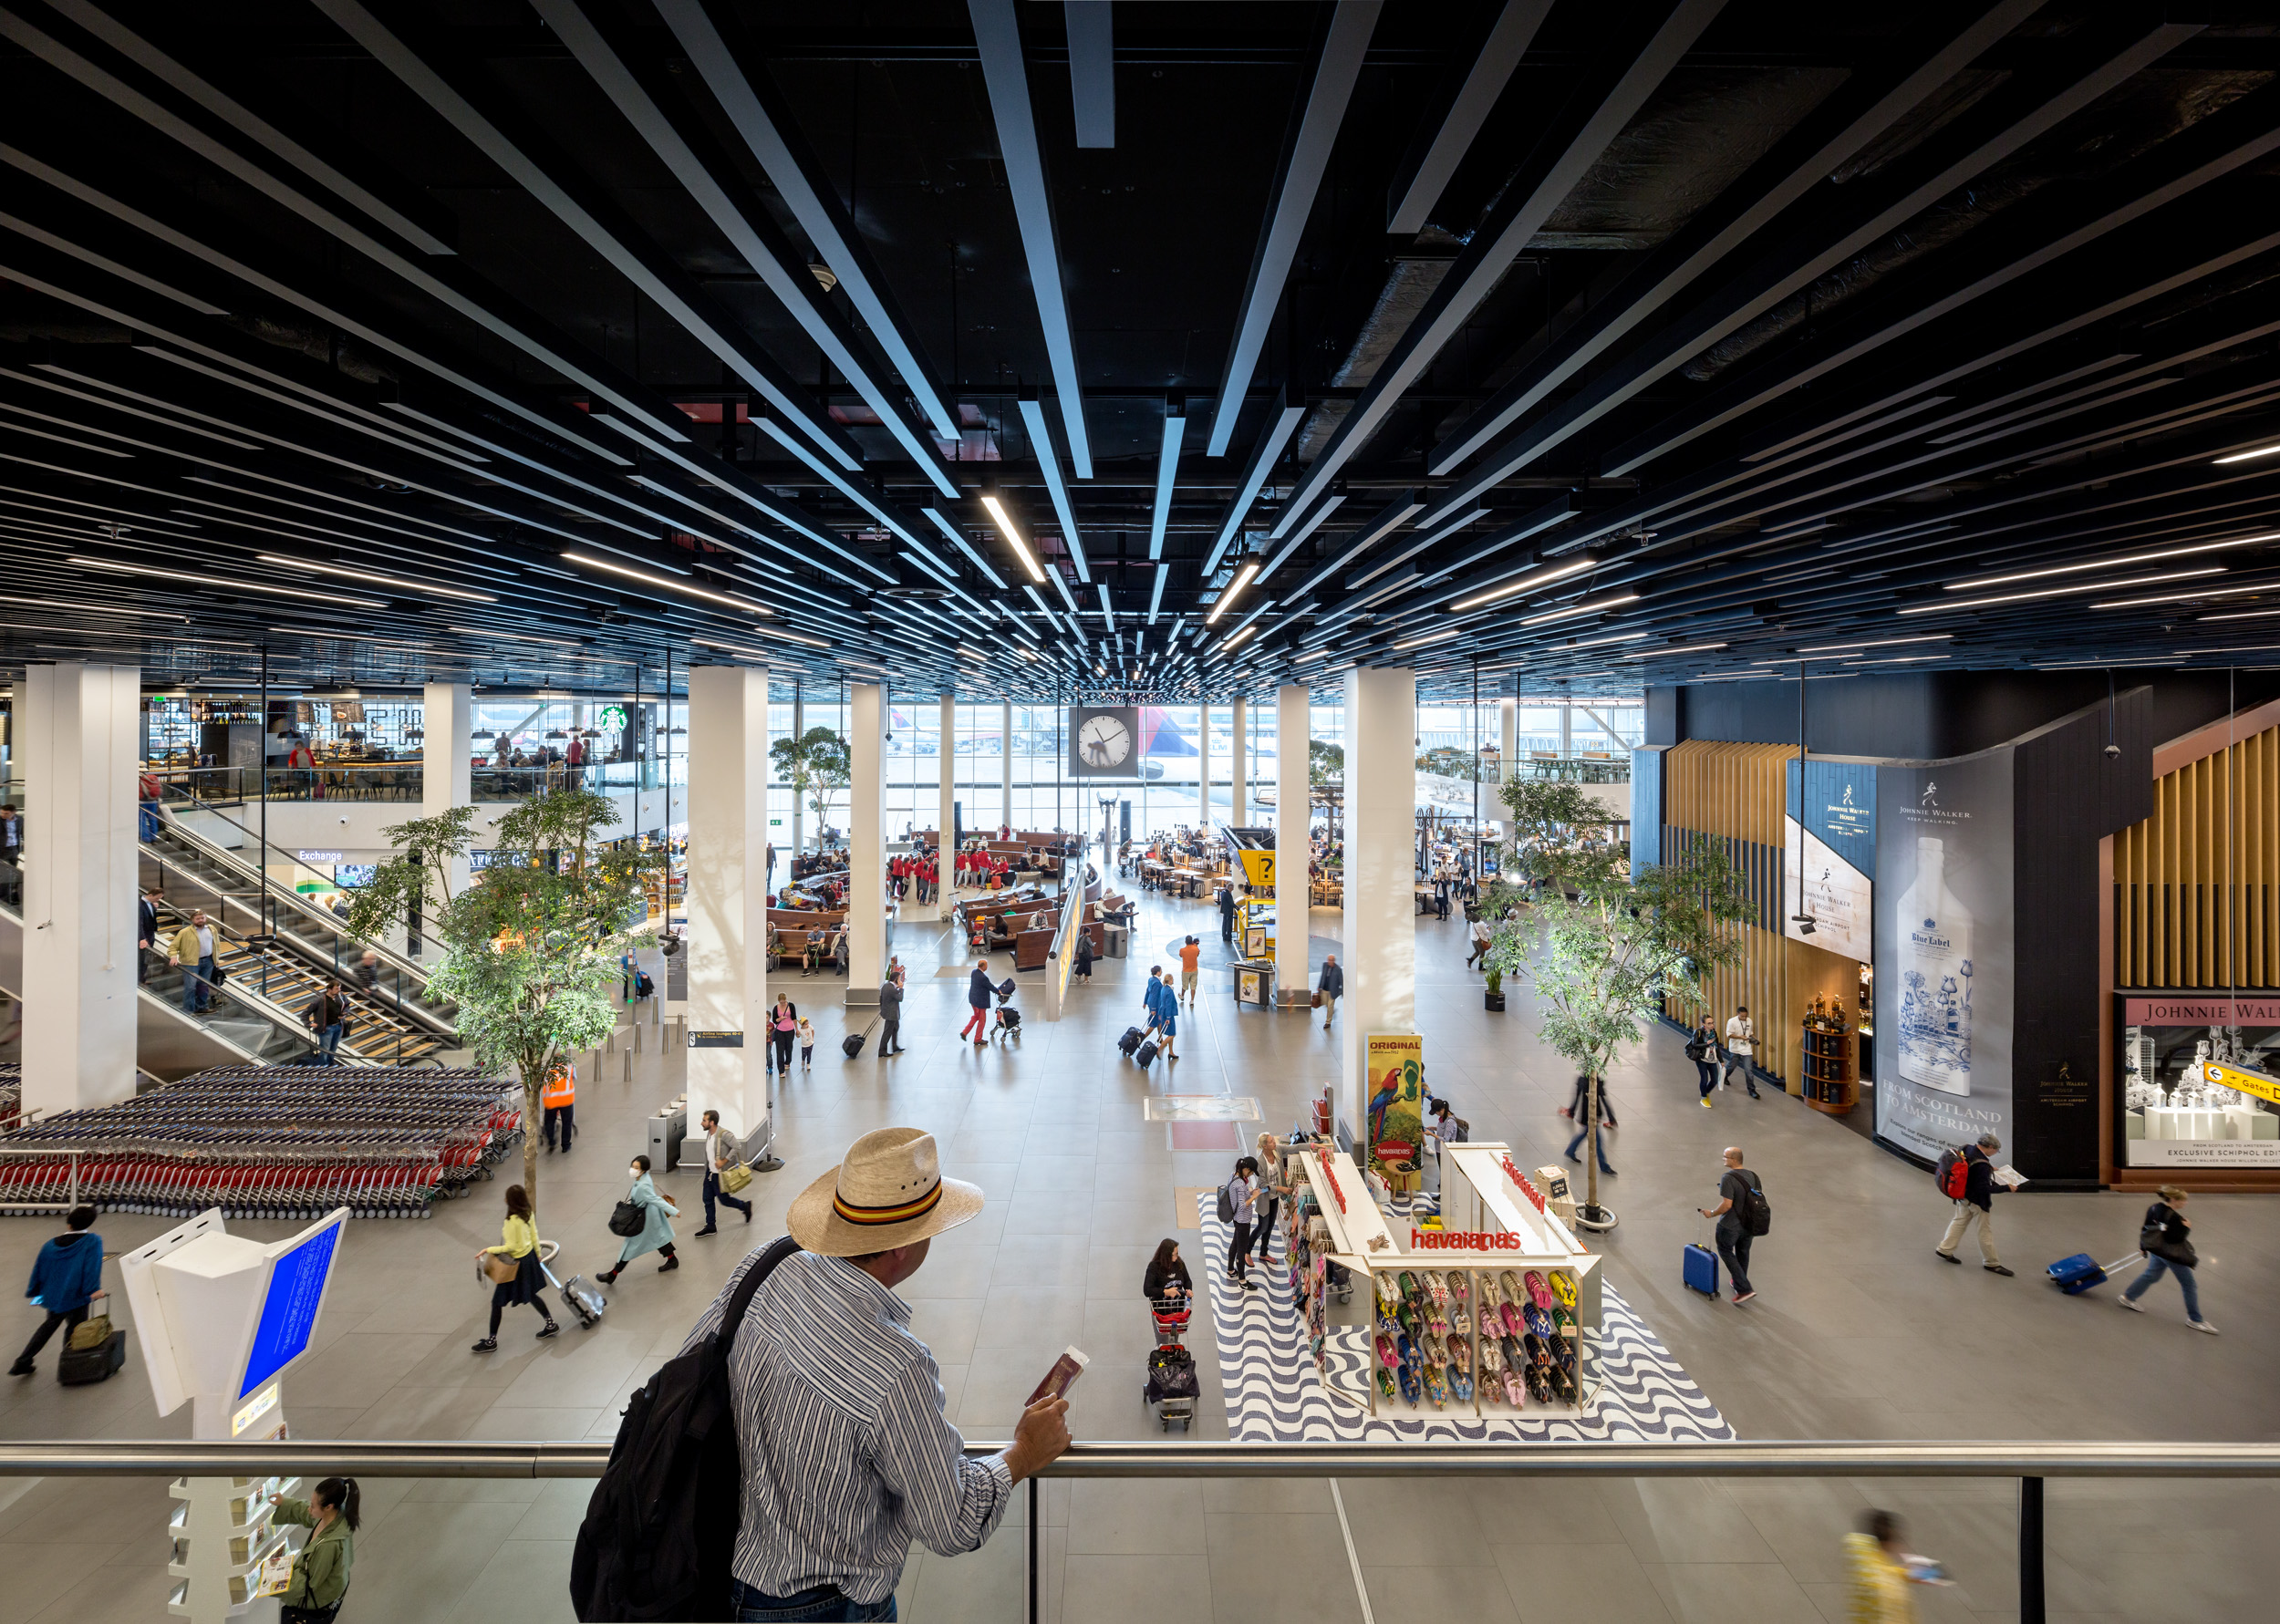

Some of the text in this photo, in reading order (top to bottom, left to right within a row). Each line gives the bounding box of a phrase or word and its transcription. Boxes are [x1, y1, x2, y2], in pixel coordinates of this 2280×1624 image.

[1900, 806, 1930, 815] JOHNNIE
[299, 850, 343, 863] Exchange
[1816, 902, 1835, 913] HOUSE
[1828, 896, 1851, 908] WALKER
[1815, 922, 1836, 933] SCHIPHOL
[1829, 921, 1850, 931] AIRPORT
[1912, 932, 1950, 947] Blue Label
[2144, 1003, 2227, 1022] JOHNNIE
[2242, 1079, 2270, 1094] Gates
[1882, 1079, 2002, 1123] FROM SCOTLAND
[1885, 1093, 1997, 1137] TO AMSTERDAM
[1890, 1118, 1907, 1131] Explore
[1916, 1132, 1937, 1143] ranges
[1901, 1131, 1943, 1151] blended Scotch
[1411, 1227, 1521, 1252] havaianas
